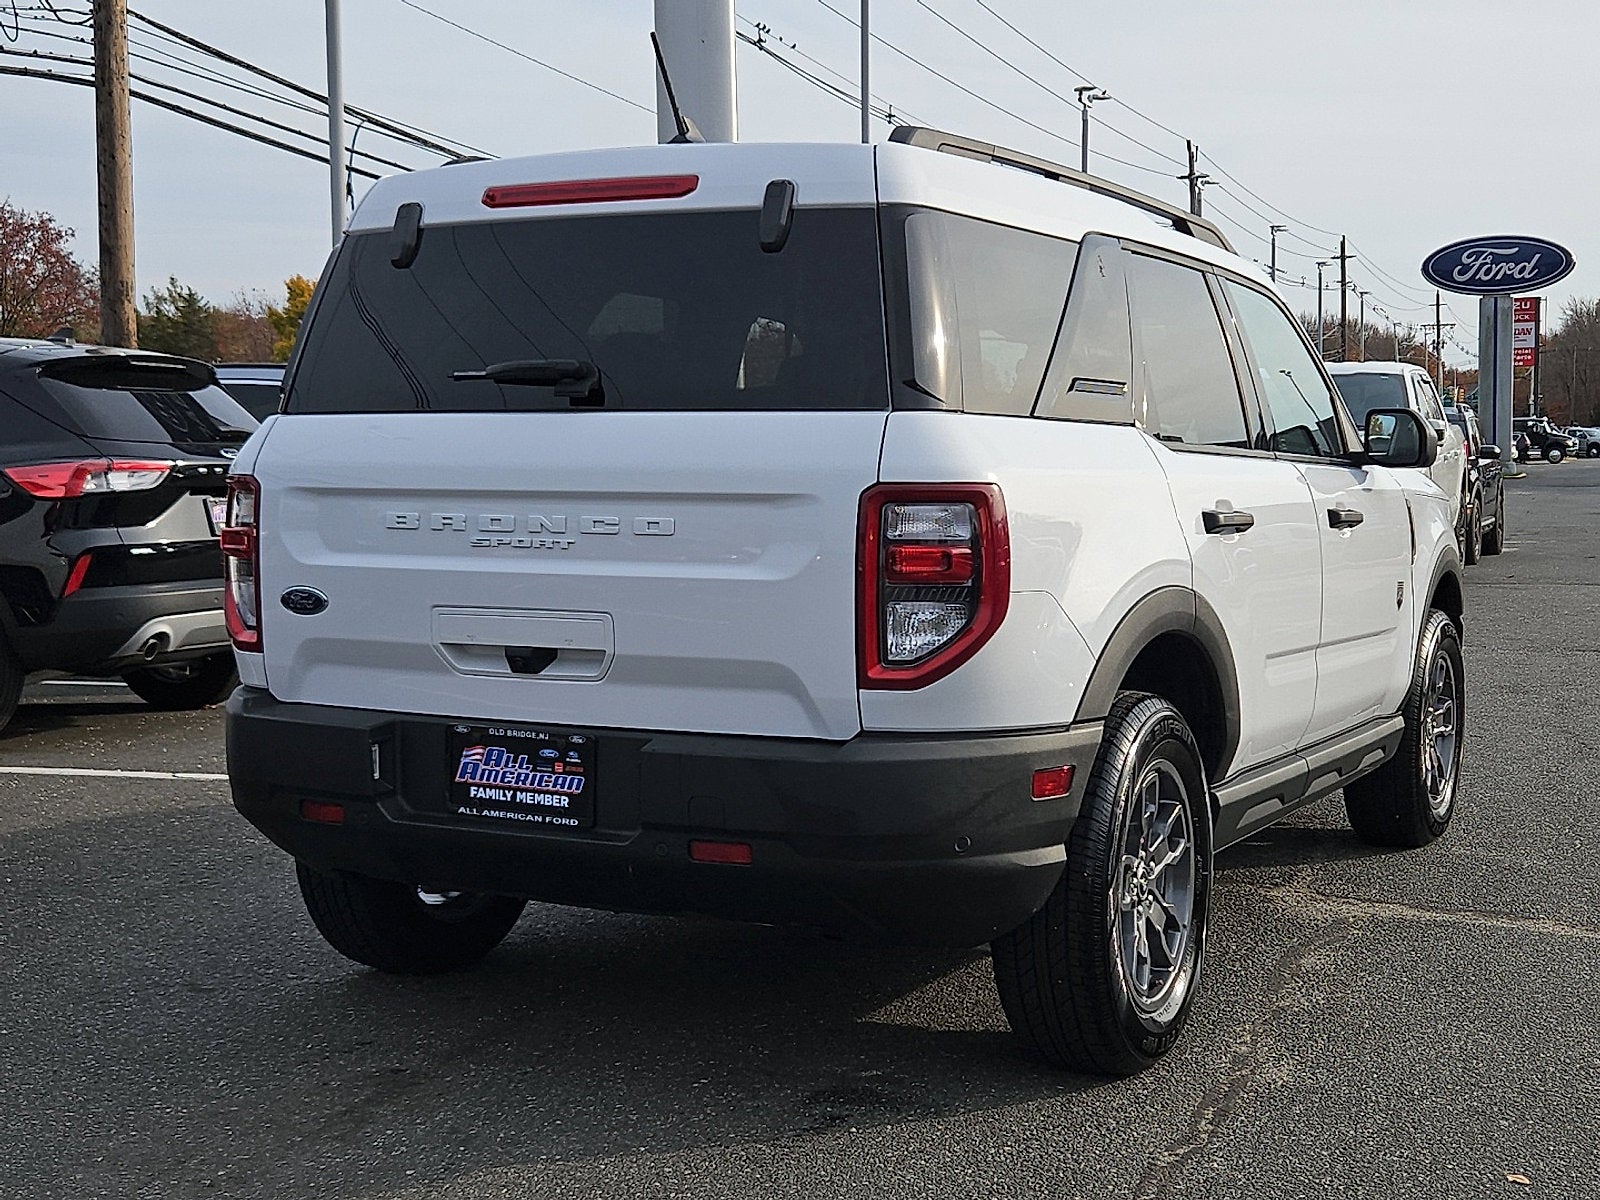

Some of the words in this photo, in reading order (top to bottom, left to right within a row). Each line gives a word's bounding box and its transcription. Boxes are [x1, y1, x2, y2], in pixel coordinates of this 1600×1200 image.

[1453, 247, 1541, 281] Ford
[1514, 301, 1531, 309] ZU
[1514, 327, 1533, 336] DAN
[385, 511, 676, 536] BRONCO
[469, 537, 576, 550] SPORT
[488, 727, 505, 736] OLD
[455, 761, 585, 794] AMERICAN
[469, 786, 514, 801] FAMILY
[516, 791, 570, 808] MEMBER
[457, 806, 480, 815] ALL
[481, 809, 543, 822] AMERICAN
[545, 816, 579, 826] FORD
